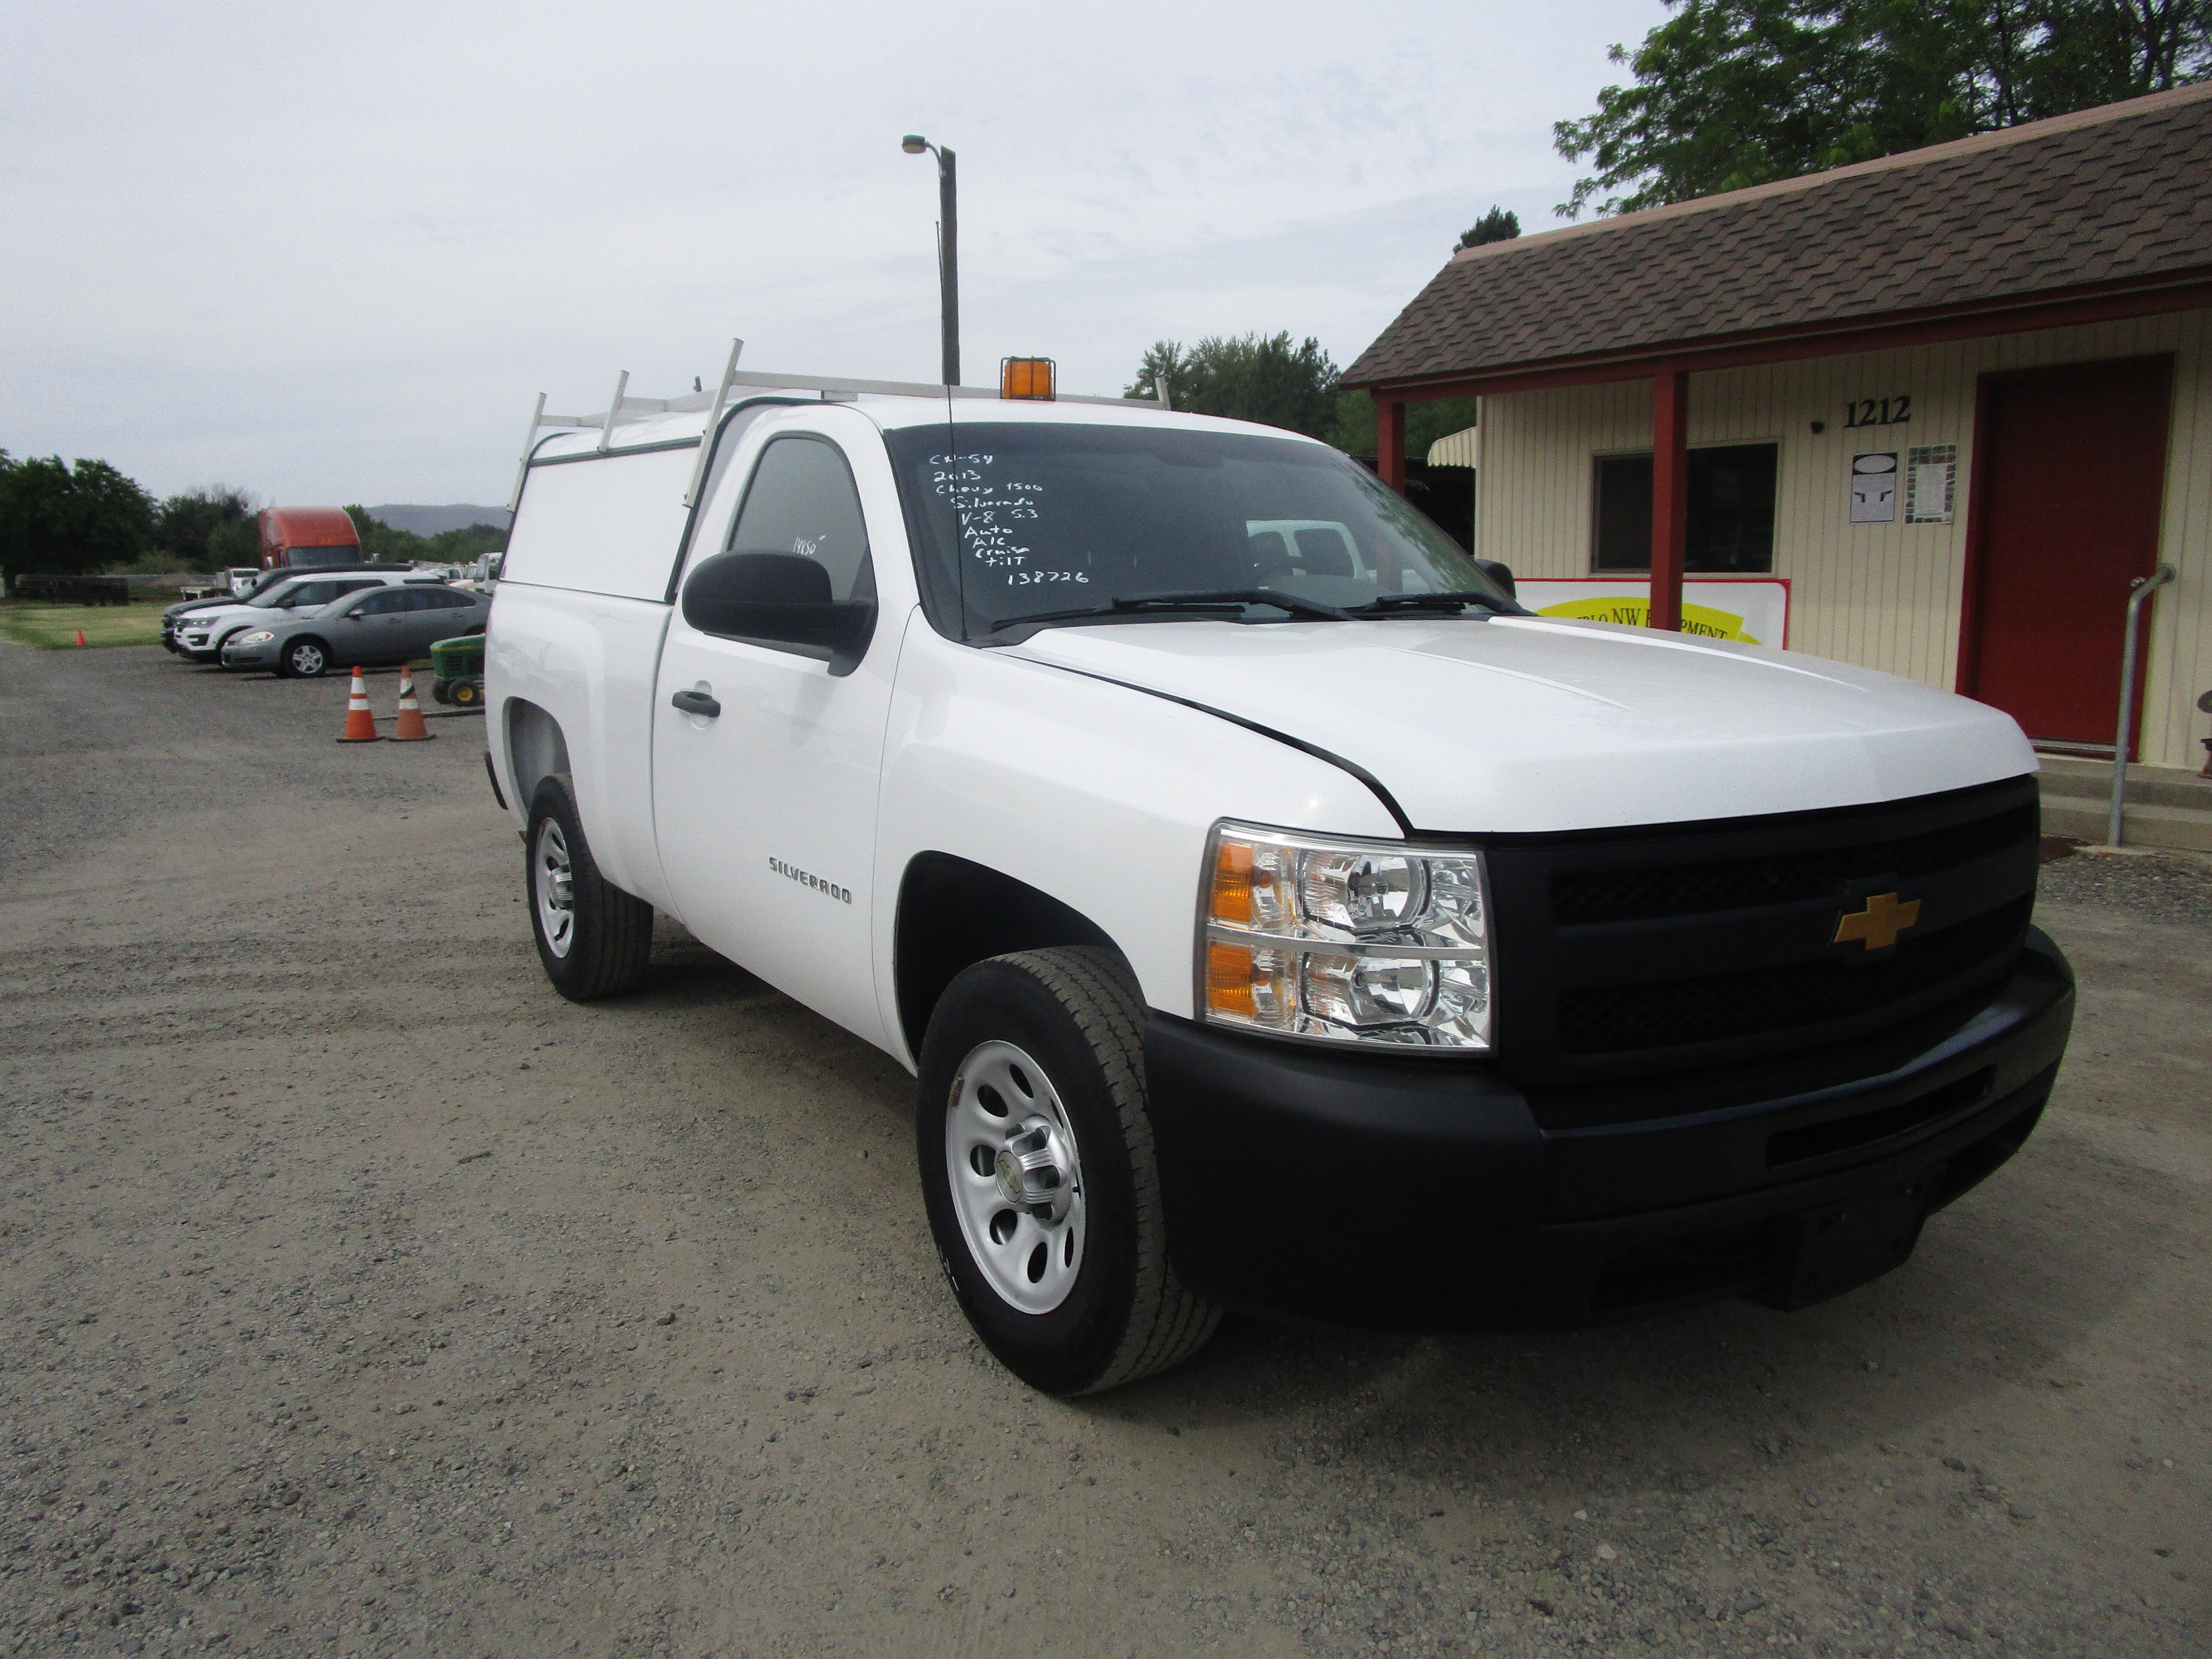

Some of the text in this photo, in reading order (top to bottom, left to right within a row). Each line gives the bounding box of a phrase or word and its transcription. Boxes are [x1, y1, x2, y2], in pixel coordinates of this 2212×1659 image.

[1844, 395, 1911, 428] 1212
[934, 469, 981, 482] 2013
[936, 482, 1042, 494] Chevy 1500
[962, 509, 1038, 525] V-8 5.3
[964, 525, 1013, 538] Auto
[1008, 571, 1089, 585] 138726
[1612, 608, 1641, 626] NW
[769, 856, 852, 905] SILVERADO
